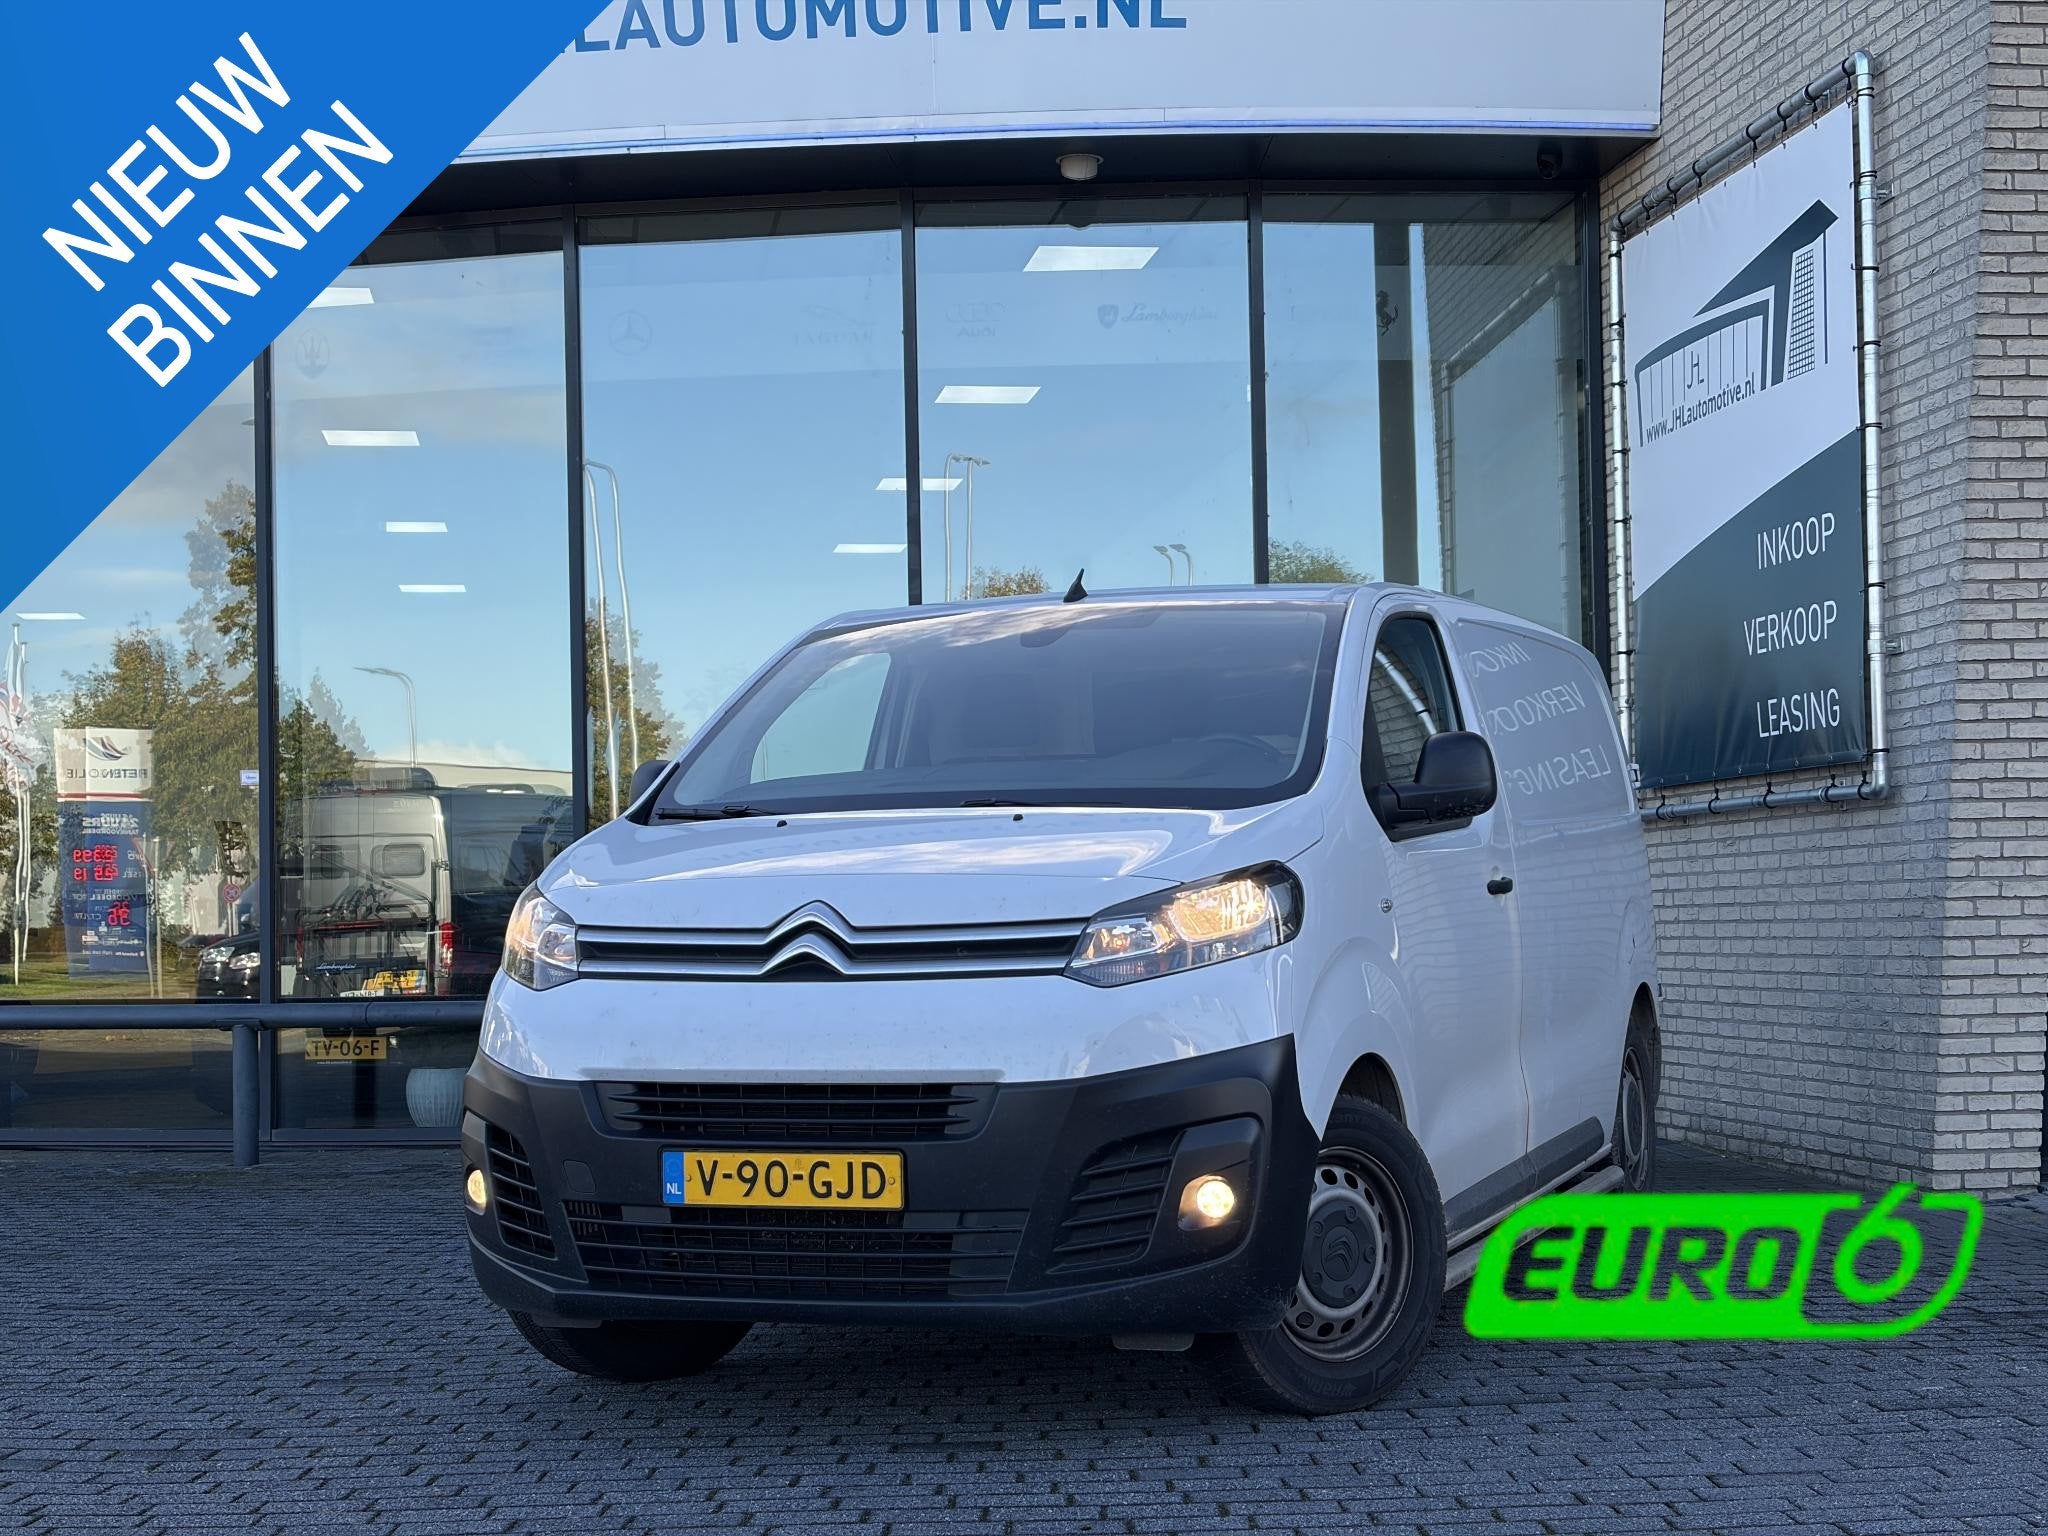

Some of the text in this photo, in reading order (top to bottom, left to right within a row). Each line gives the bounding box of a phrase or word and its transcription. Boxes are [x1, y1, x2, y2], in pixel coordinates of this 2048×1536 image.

[561, 0, 1187, 53] LAUTOMOTIVE.NL
[1646, 371, 1755, 444] www.JHLautomotive.nl
[1757, 512, 1836, 570] INKOOP
[1743, 600, 1838, 656] VERKOOP
[1756, 688, 1841, 738] LEASING
[666, 1159, 887, 1199] NL V-90-GJD
